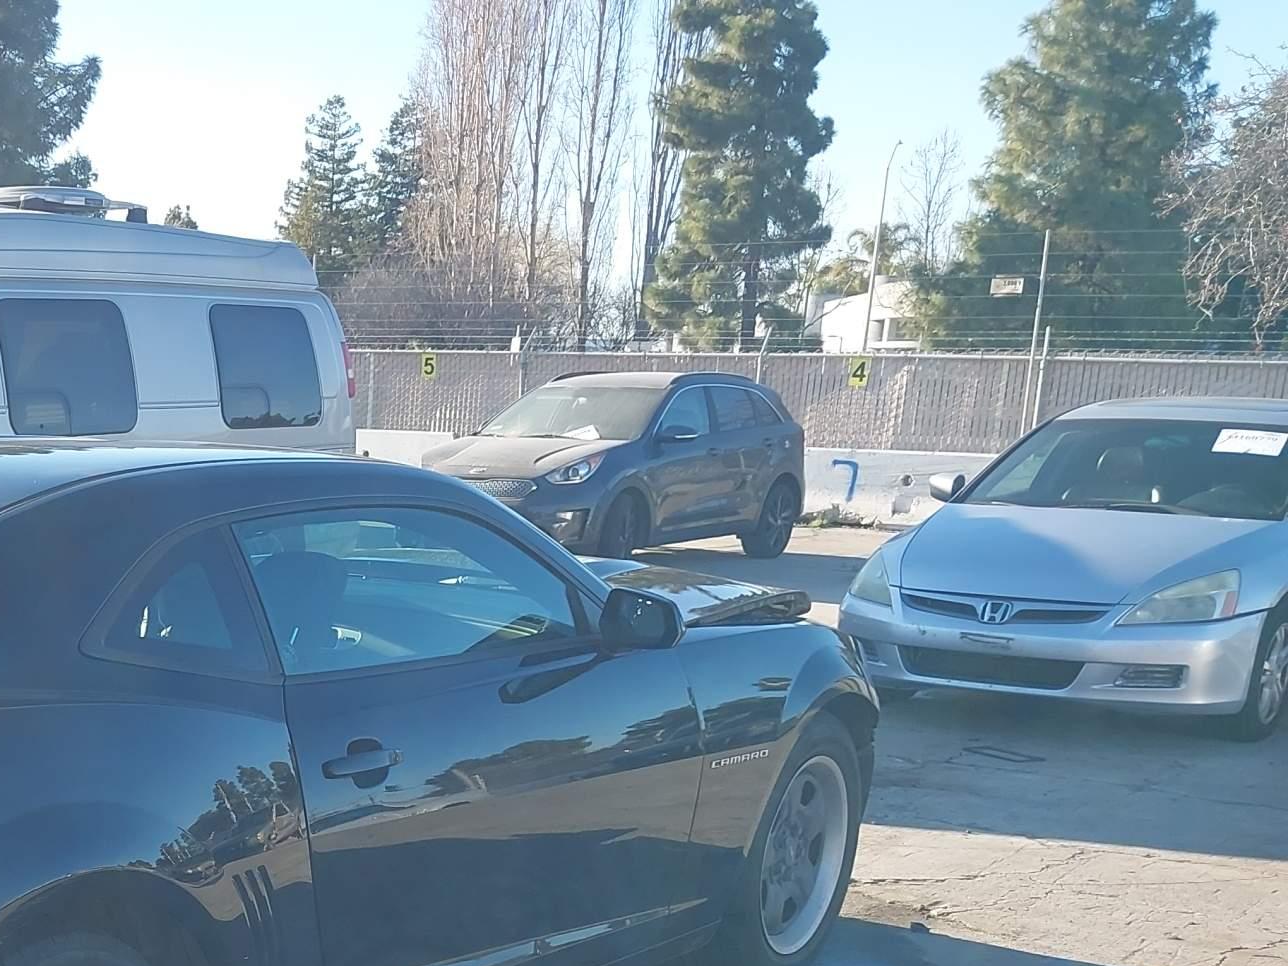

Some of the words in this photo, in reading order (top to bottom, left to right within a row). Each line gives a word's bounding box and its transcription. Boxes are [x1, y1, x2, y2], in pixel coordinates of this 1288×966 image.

[424, 357, 434, 375] 5
[852, 361, 867, 382] 4
[832, 459, 859, 503] 7
[711, 749, 769, 769] CAMARO
